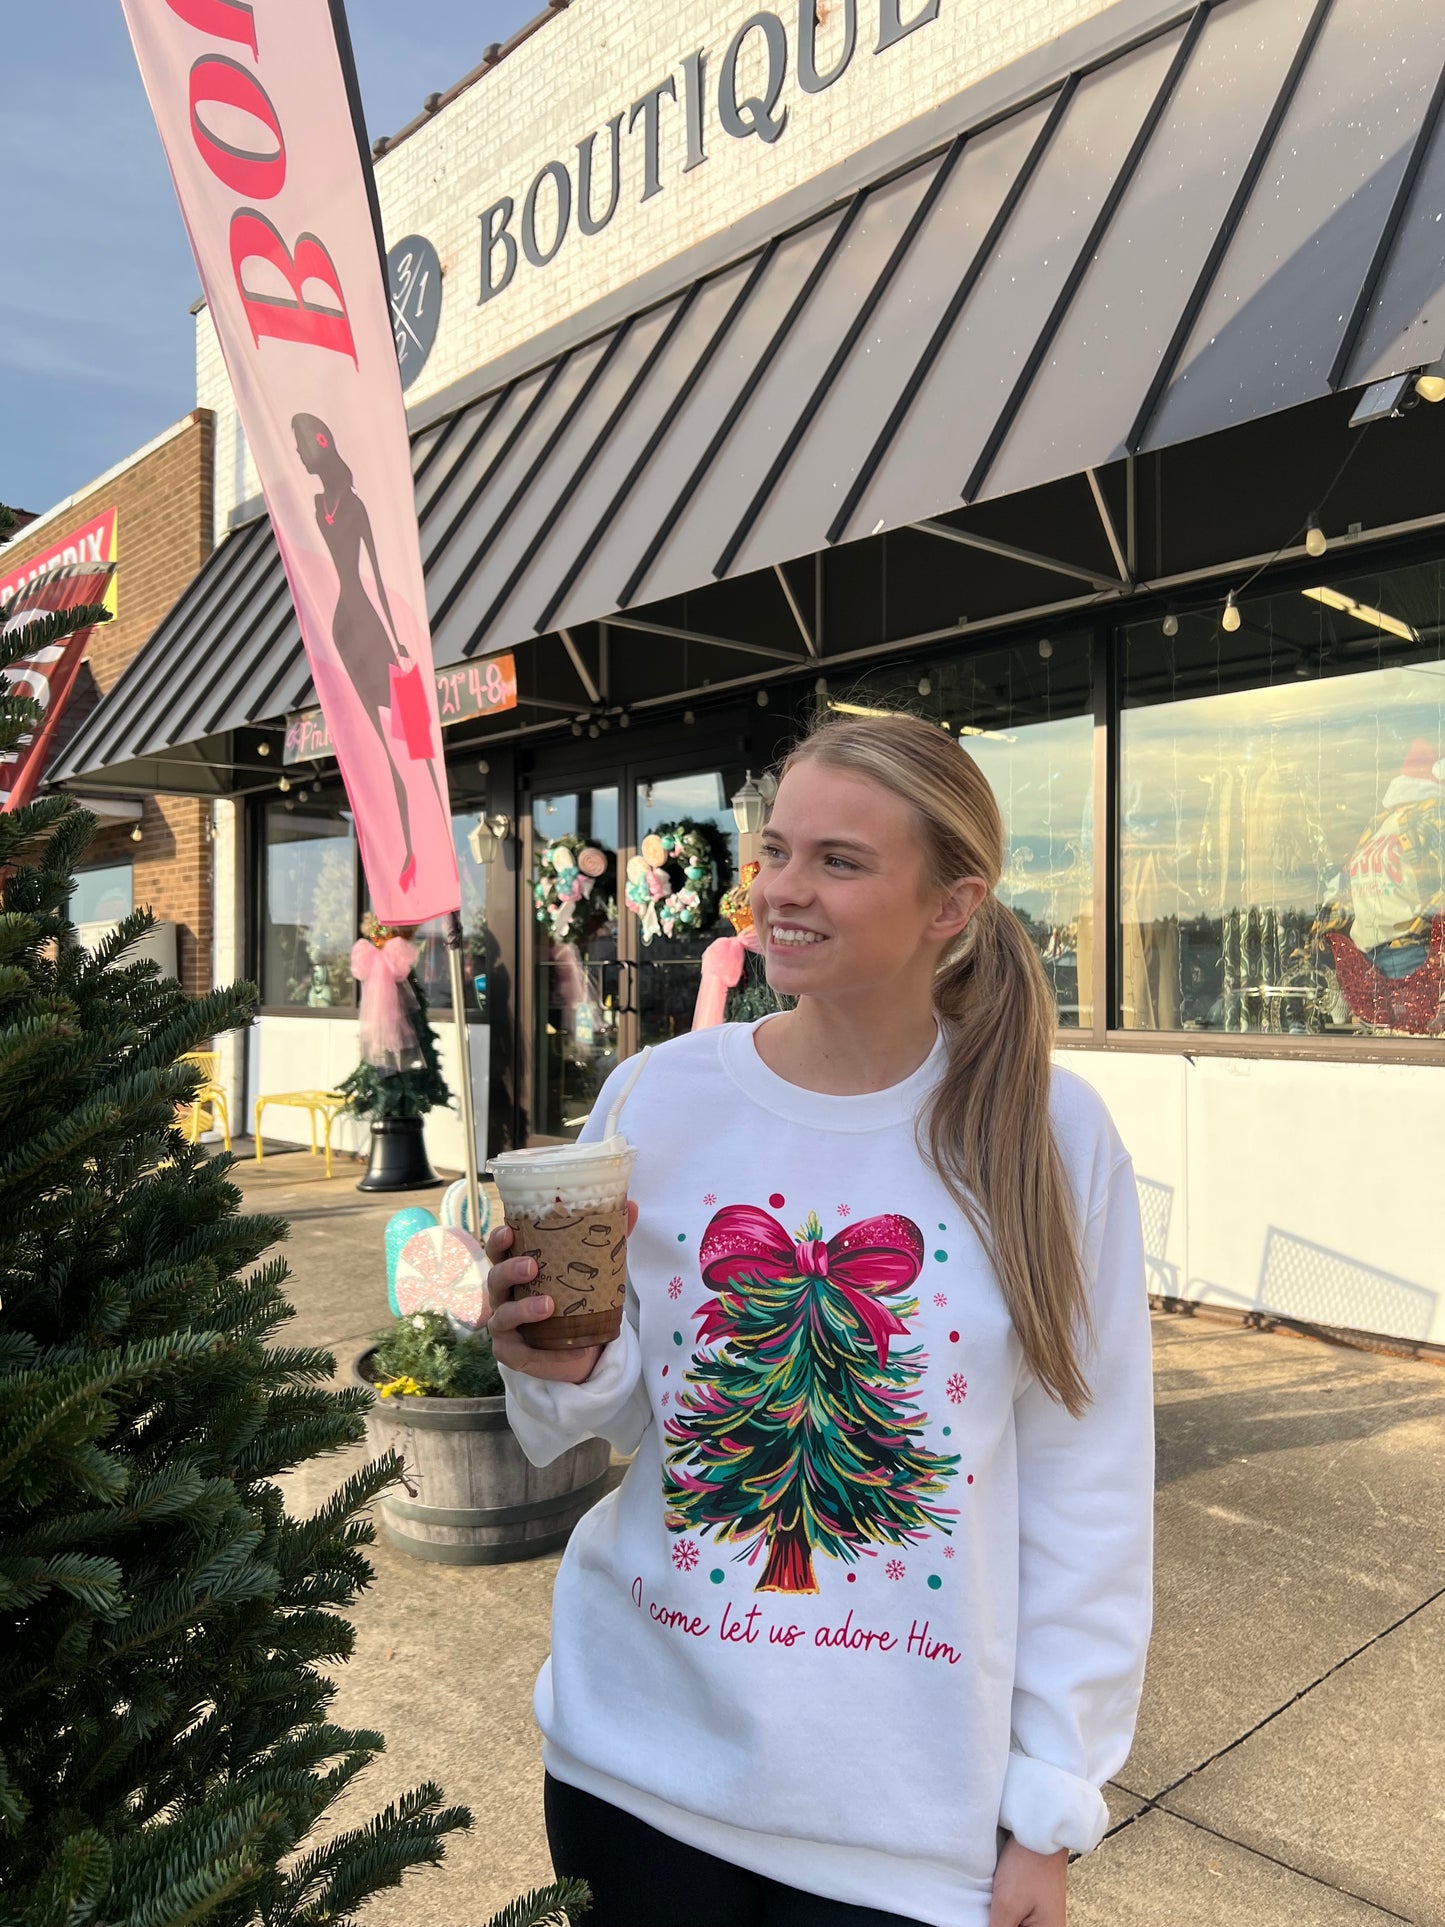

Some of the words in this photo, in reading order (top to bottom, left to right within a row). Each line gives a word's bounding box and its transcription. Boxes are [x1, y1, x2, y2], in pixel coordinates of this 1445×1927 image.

[650, 1602, 710, 1636] come
[720, 1602, 762, 1643] let
[769, 1625, 806, 1647] us
[814, 1609, 898, 1651] adore
[907, 1619, 962, 1664] Him
